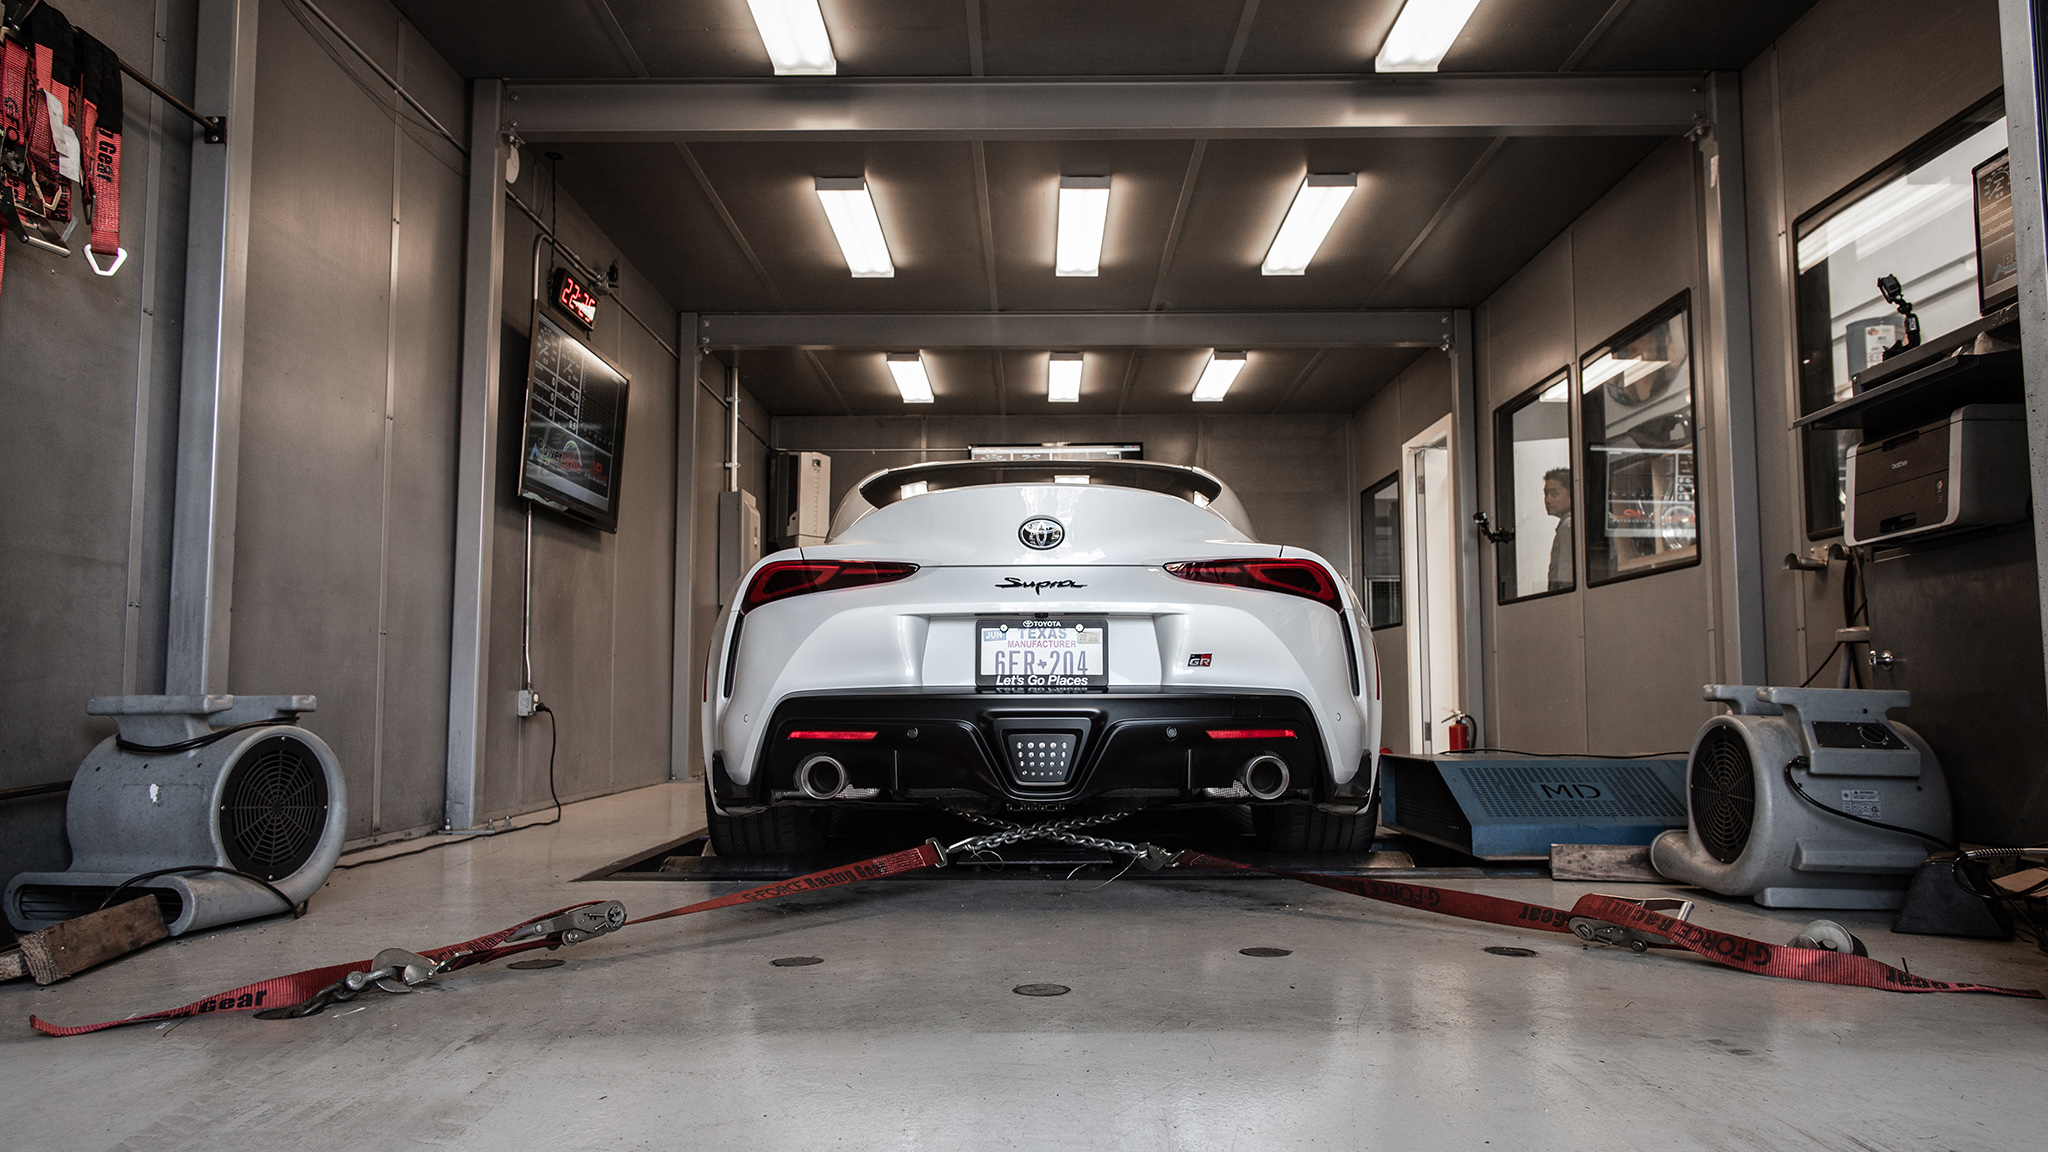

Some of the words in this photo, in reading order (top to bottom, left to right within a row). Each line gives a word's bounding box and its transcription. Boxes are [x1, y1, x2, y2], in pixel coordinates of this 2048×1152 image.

[97, 143, 117, 183] Gear
[537, 437, 581, 473] PowerDyne
[994, 577, 1088, 596] Supra
[985, 631, 1003, 640] JUN
[1018, 628, 1067, 640] TEXAS
[1007, 640, 1077, 649] MANUFACTURER
[1190, 658, 1211, 666] GR
[996, 675, 1027, 686] Let's
[1027, 675, 1046, 686] Go
[1047, 675, 1089, 686] Places
[1540, 784, 1602, 799] MD
[742, 880, 808, 901] G-FORCE
[803, 868, 858, 889] Racing
[853, 861, 889, 878] Gear
[1518, 905, 1569, 928] Gear
[1673, 922, 1773, 967] G-FORCE
[199, 989, 268, 1014] Gear
